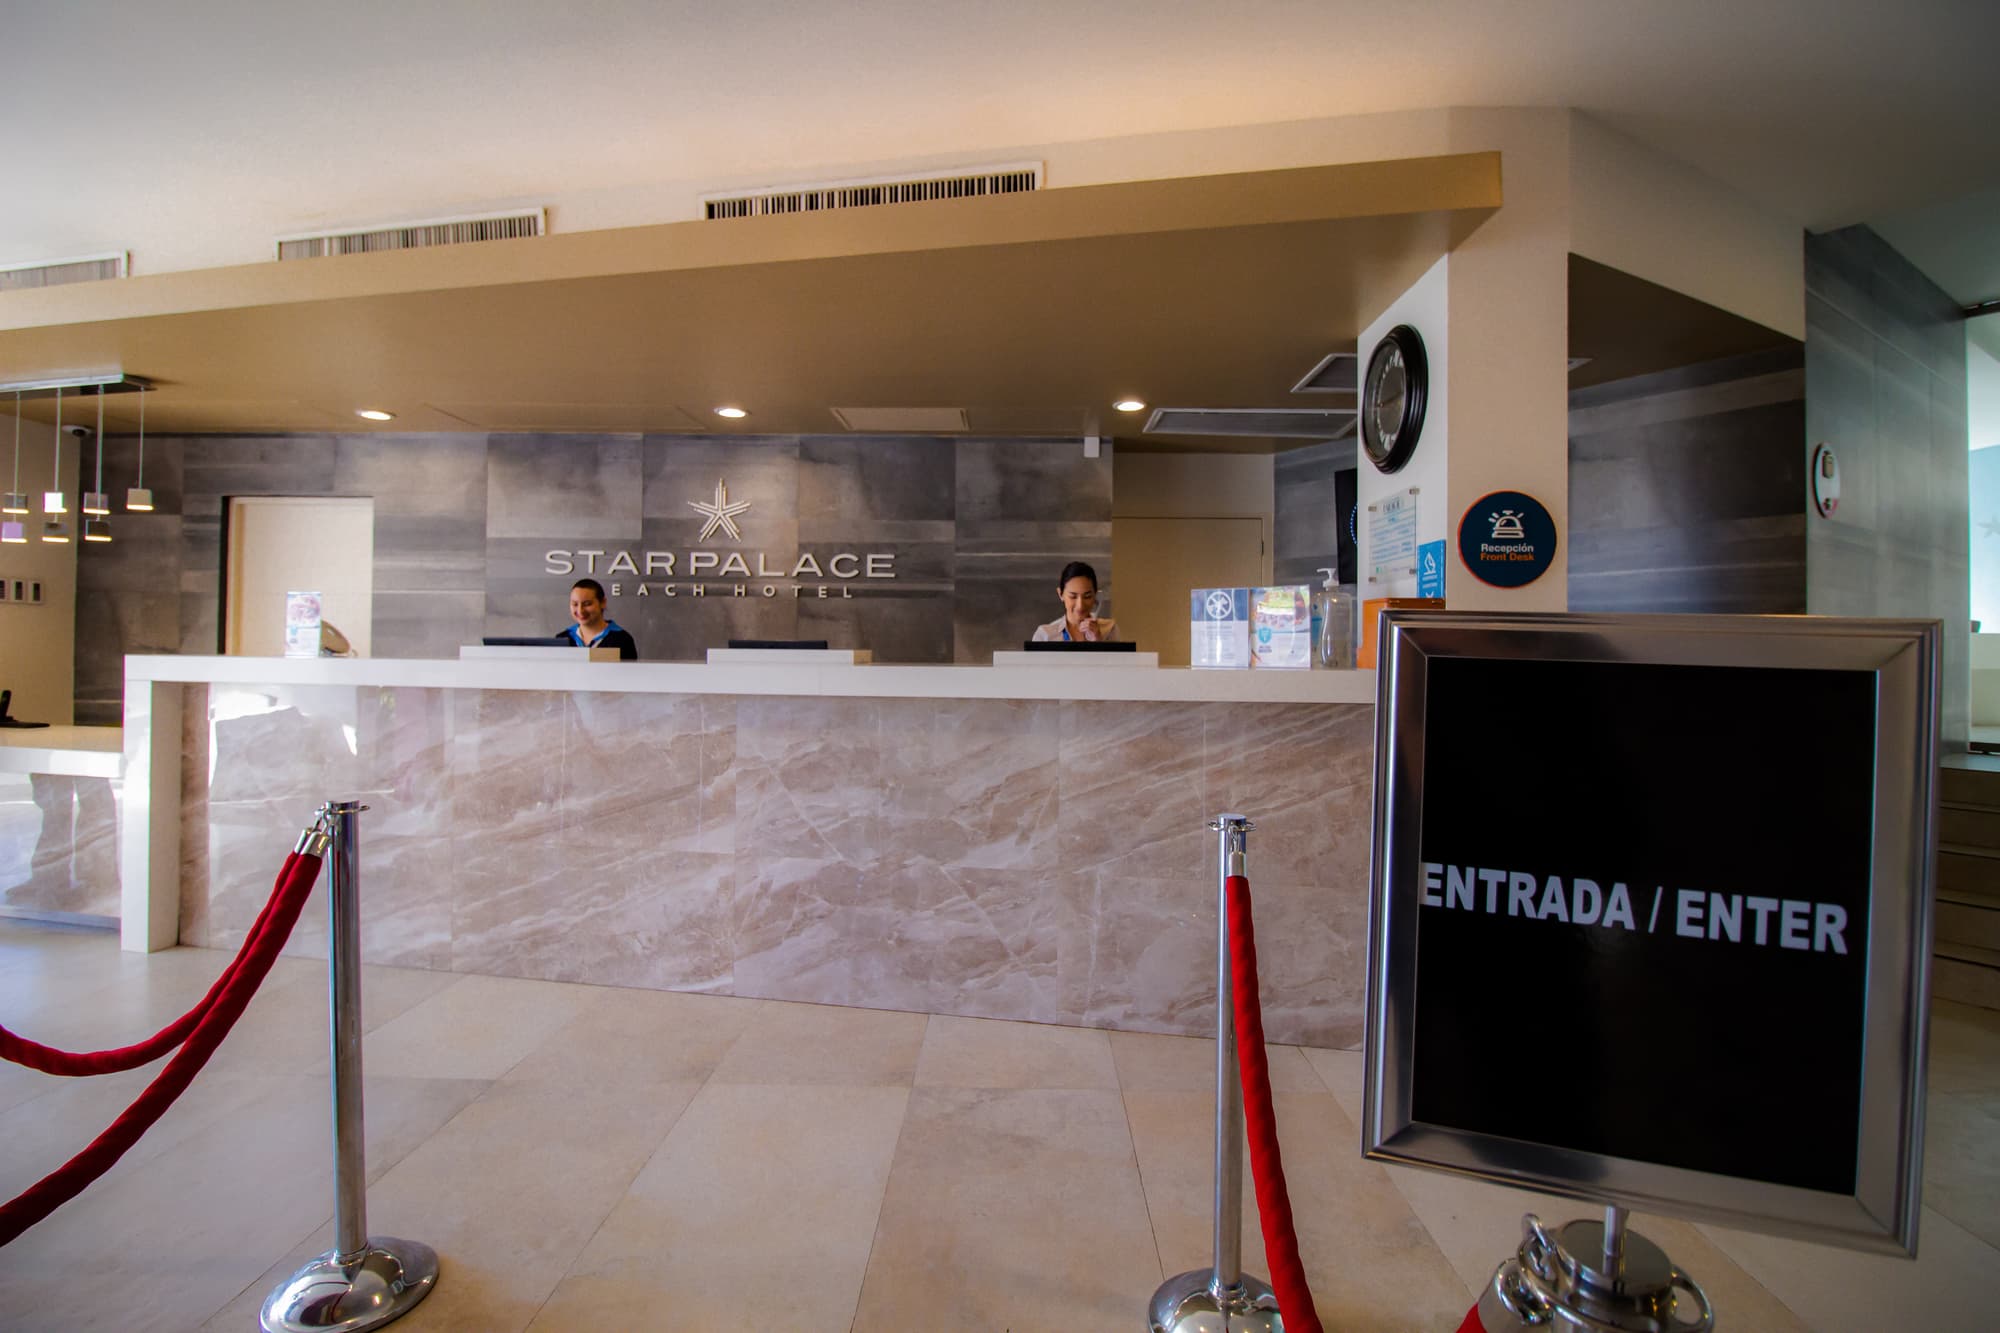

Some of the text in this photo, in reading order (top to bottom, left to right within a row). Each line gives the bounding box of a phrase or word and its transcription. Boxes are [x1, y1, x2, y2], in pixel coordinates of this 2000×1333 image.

[1481, 542, 1534, 554] Recepción
[545, 550, 896, 578] STAR PALACE
[1480, 553, 1535, 561] Front Desk
[611, 583, 852, 598] EACH HOTEL
[1419, 862, 1848, 955] ENTRADA / ENTER
